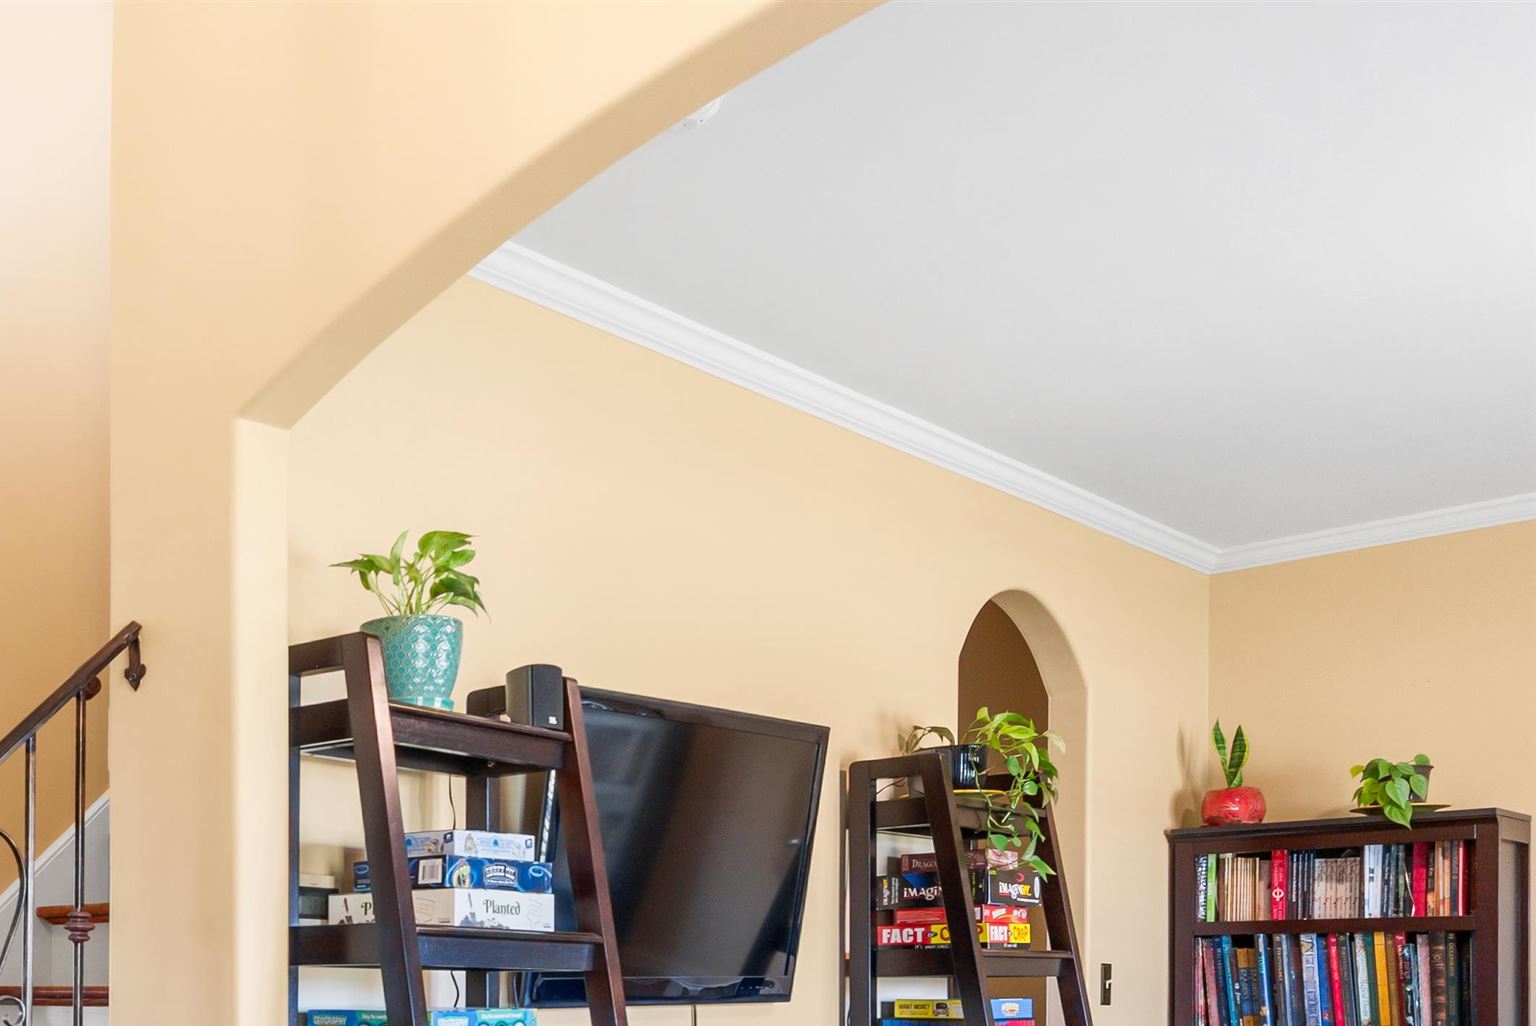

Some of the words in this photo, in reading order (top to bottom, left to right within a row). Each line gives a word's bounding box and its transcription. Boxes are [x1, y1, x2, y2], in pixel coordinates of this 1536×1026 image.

[482, 898, 521, 915] Planted
[882, 927, 926, 944] FACT
[990, 925, 1008, 941] FACT
[313, 1016, 347, 1025] GEOGRAPHY
